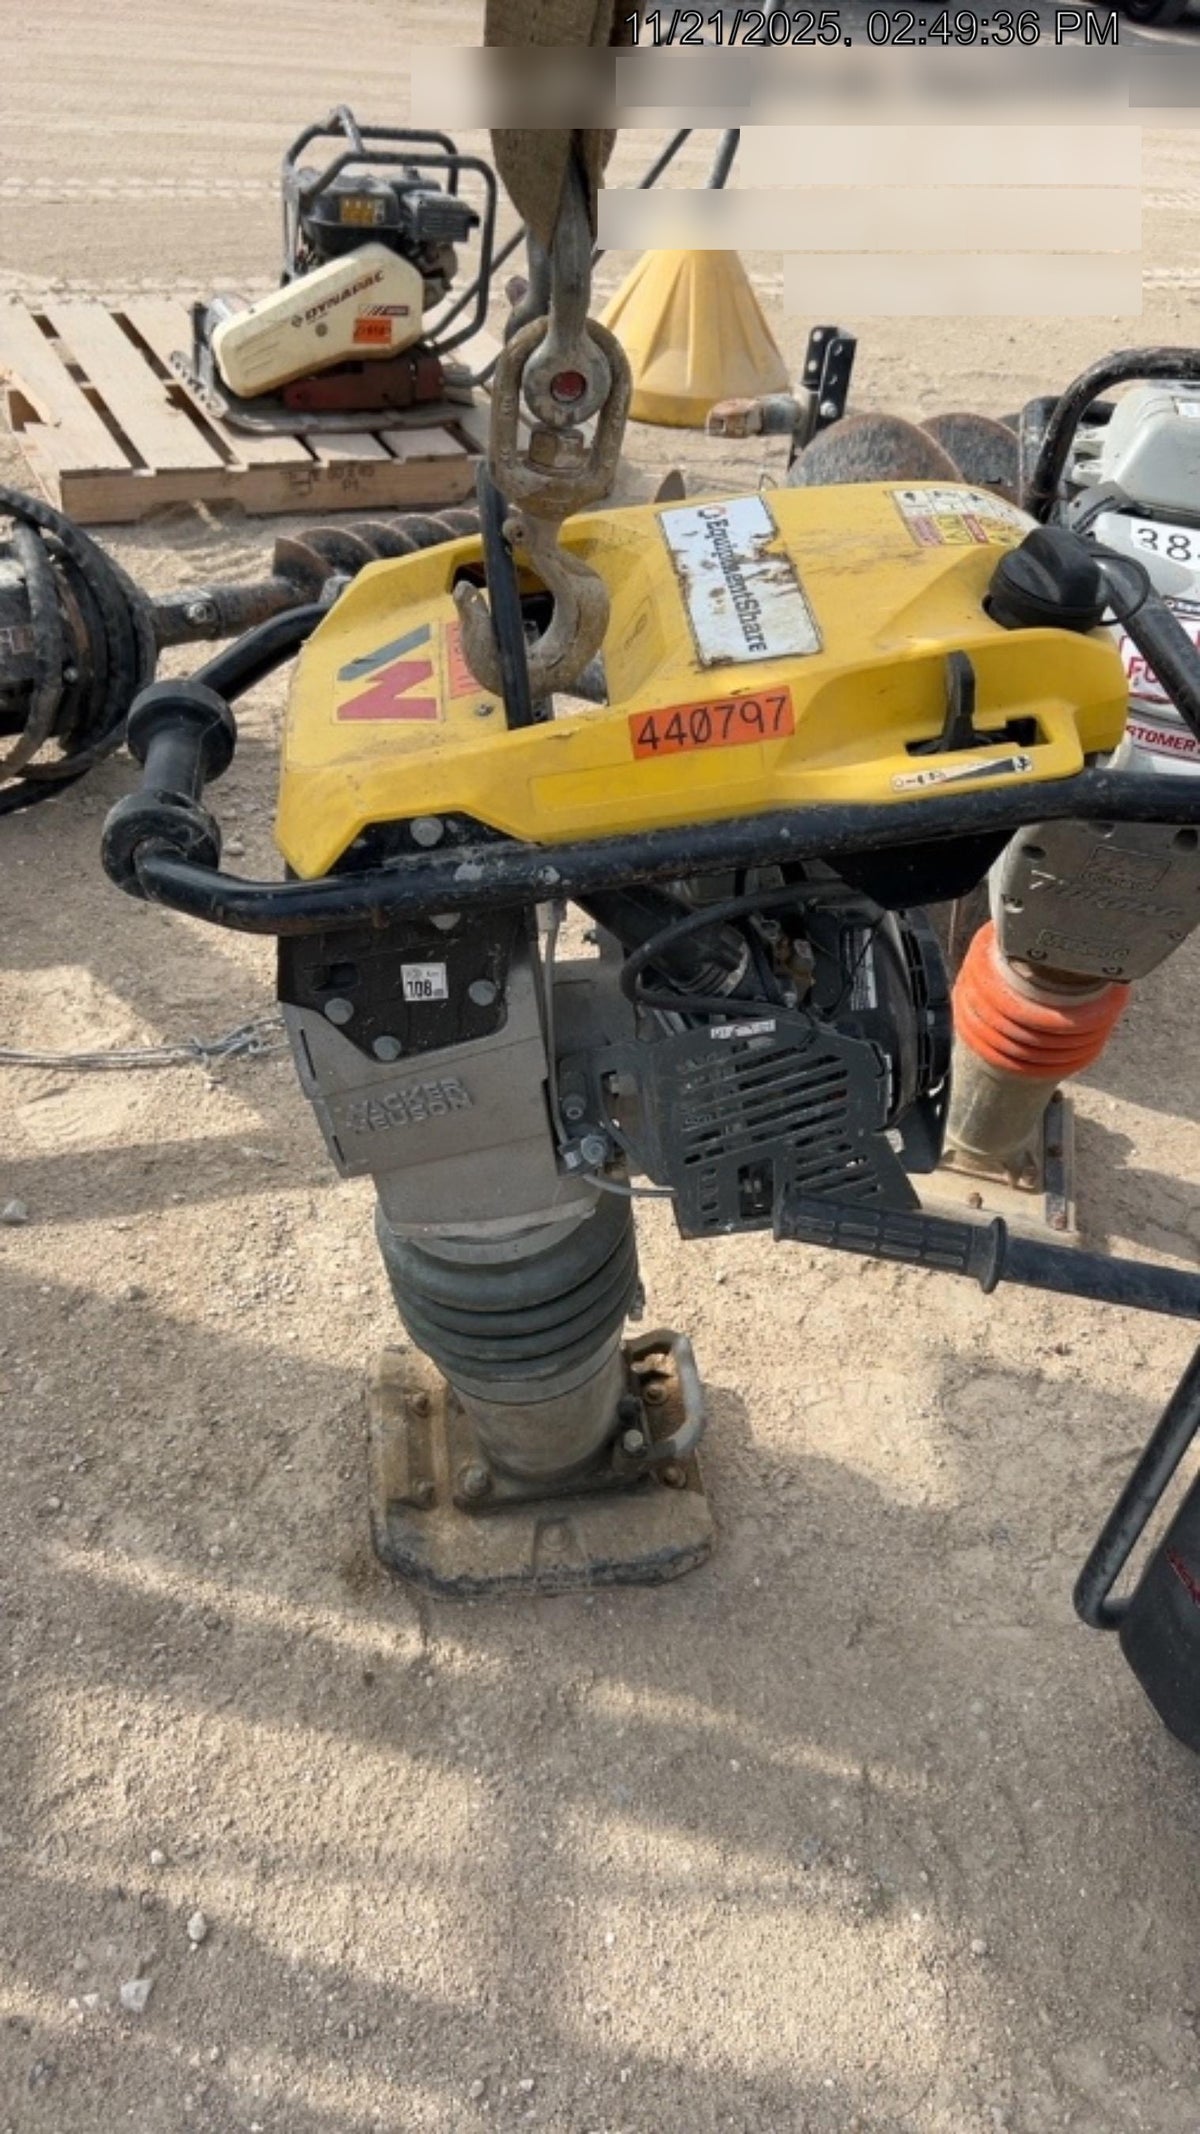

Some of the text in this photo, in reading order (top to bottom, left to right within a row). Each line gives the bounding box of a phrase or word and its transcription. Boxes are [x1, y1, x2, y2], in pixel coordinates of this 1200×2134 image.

[1137, 527, 1200, 562] 38
[704, 519, 768, 653] EquipmentShare
[637, 696, 786, 750] 440797
[1126, 725, 1196, 752] STOMER
[407, 980, 432, 998] 108
